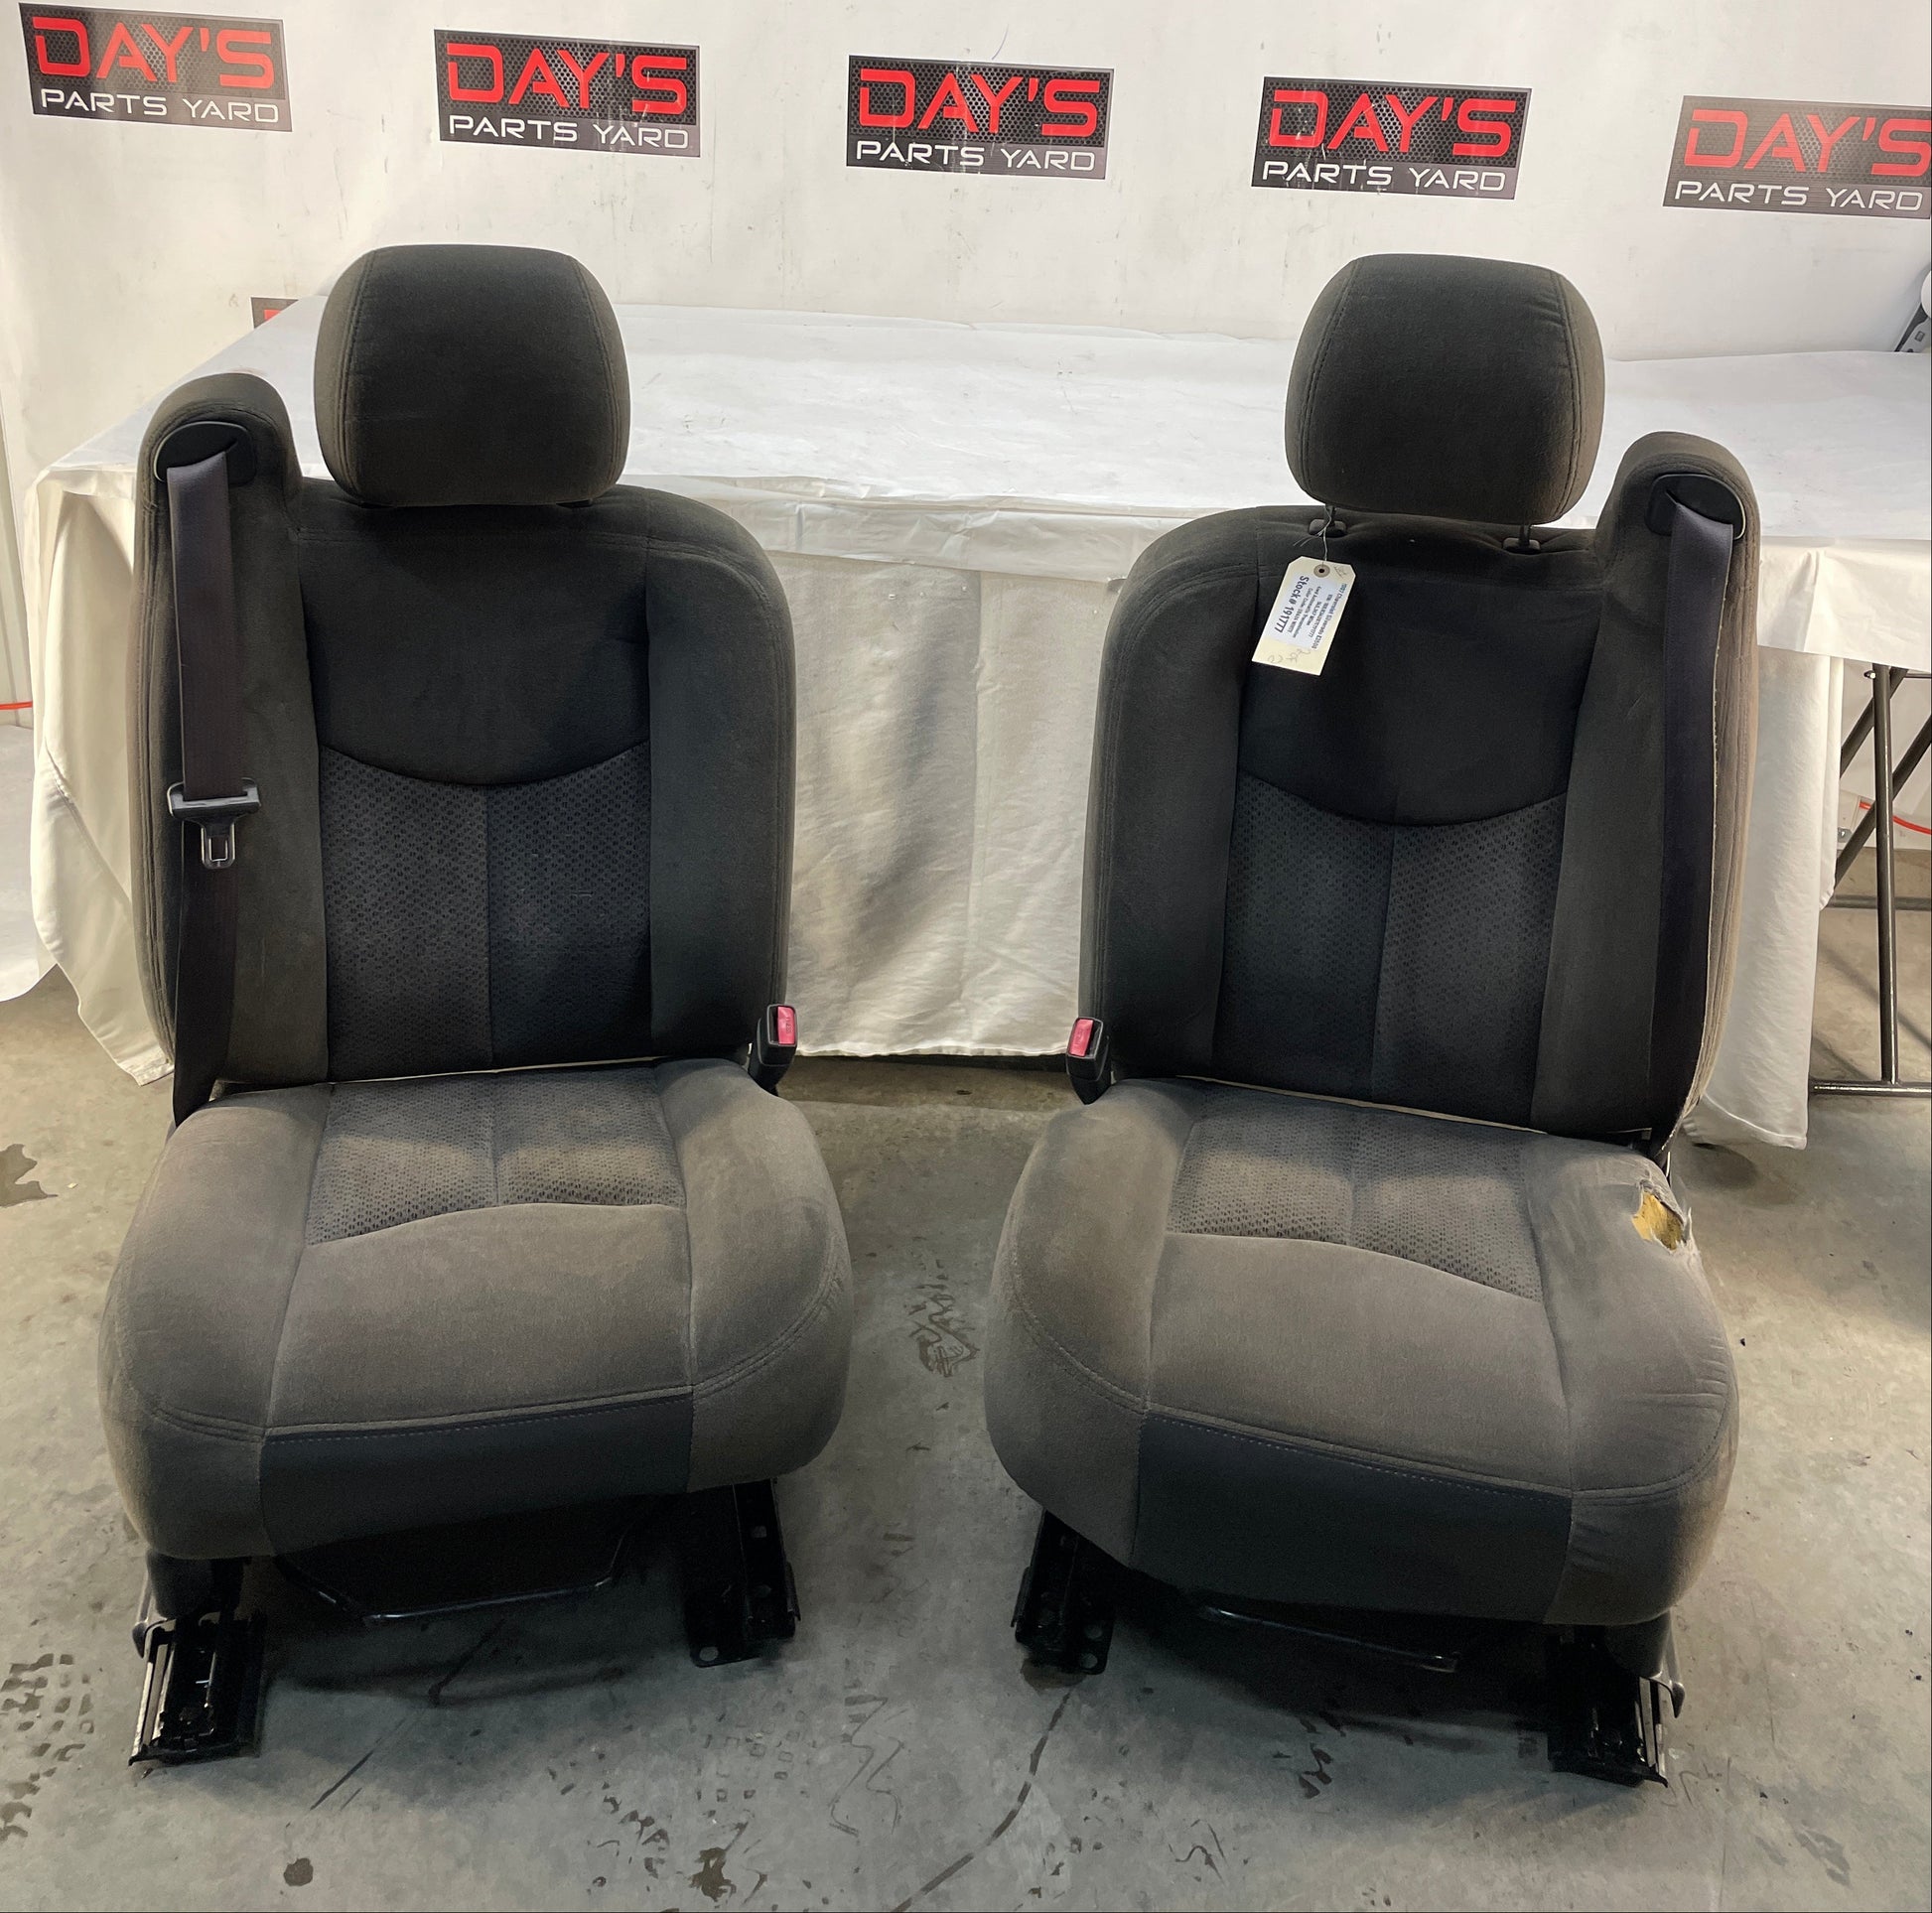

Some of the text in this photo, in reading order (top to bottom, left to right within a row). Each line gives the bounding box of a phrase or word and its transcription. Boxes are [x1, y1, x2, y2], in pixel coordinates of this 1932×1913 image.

[32, 16, 274, 88] DAY'S
[447, 43, 687, 115] DAY'S
[40, 88, 279, 123] PARTS YARD
[859, 68, 1100, 138] DAY'S
[449, 115, 689, 149] PARTS YARD
[1269, 89, 1517, 158] DAY'S
[856, 140, 1095, 171] PARTS YARD
[1684, 109, 1931, 178] DAY'S
[1262, 160, 1506, 192] PARTS YARD
[1674, 180, 1924, 211] PARTS YARD
[1274, 607, 1295, 633] 191777
